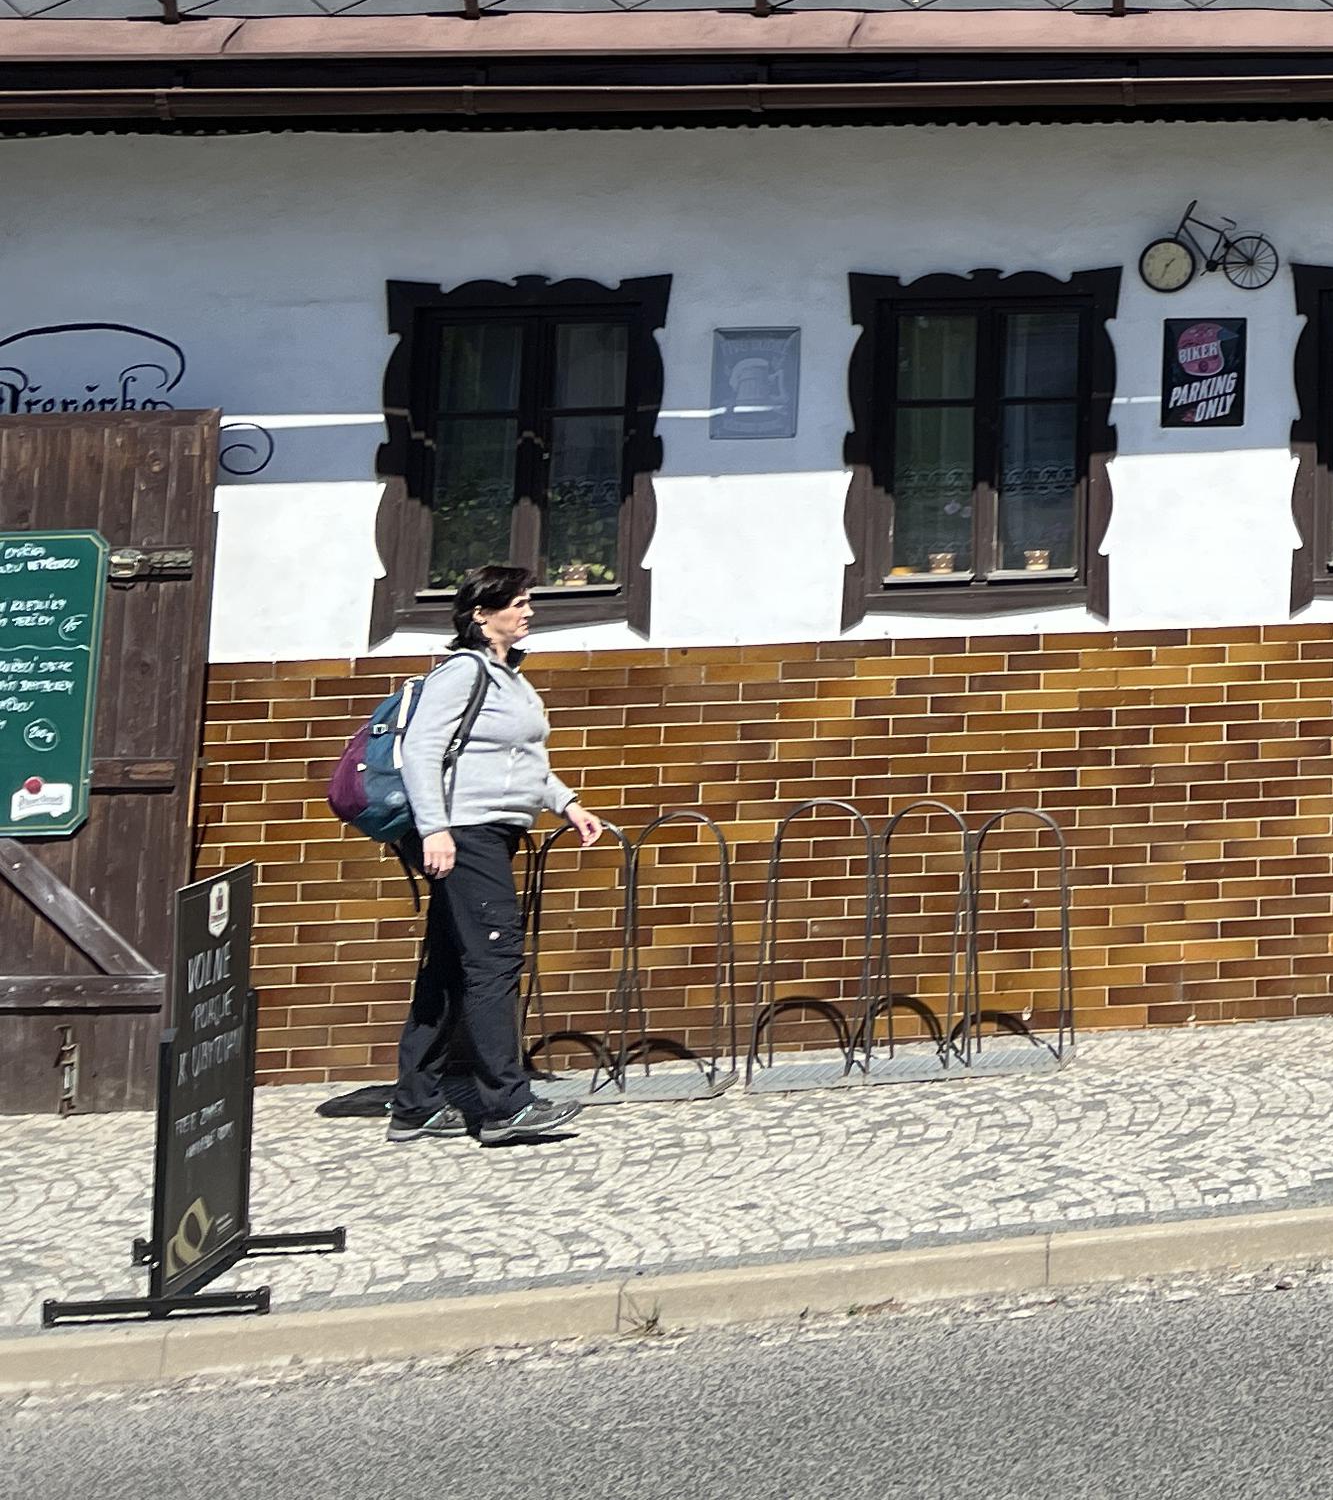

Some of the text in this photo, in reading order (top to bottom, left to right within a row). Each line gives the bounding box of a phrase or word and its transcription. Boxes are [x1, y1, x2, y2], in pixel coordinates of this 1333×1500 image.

[1179, 341, 1218, 364] BIKER
[1169, 372, 1238, 409] PARKING
[1194, 393, 1236, 422] ONLY
